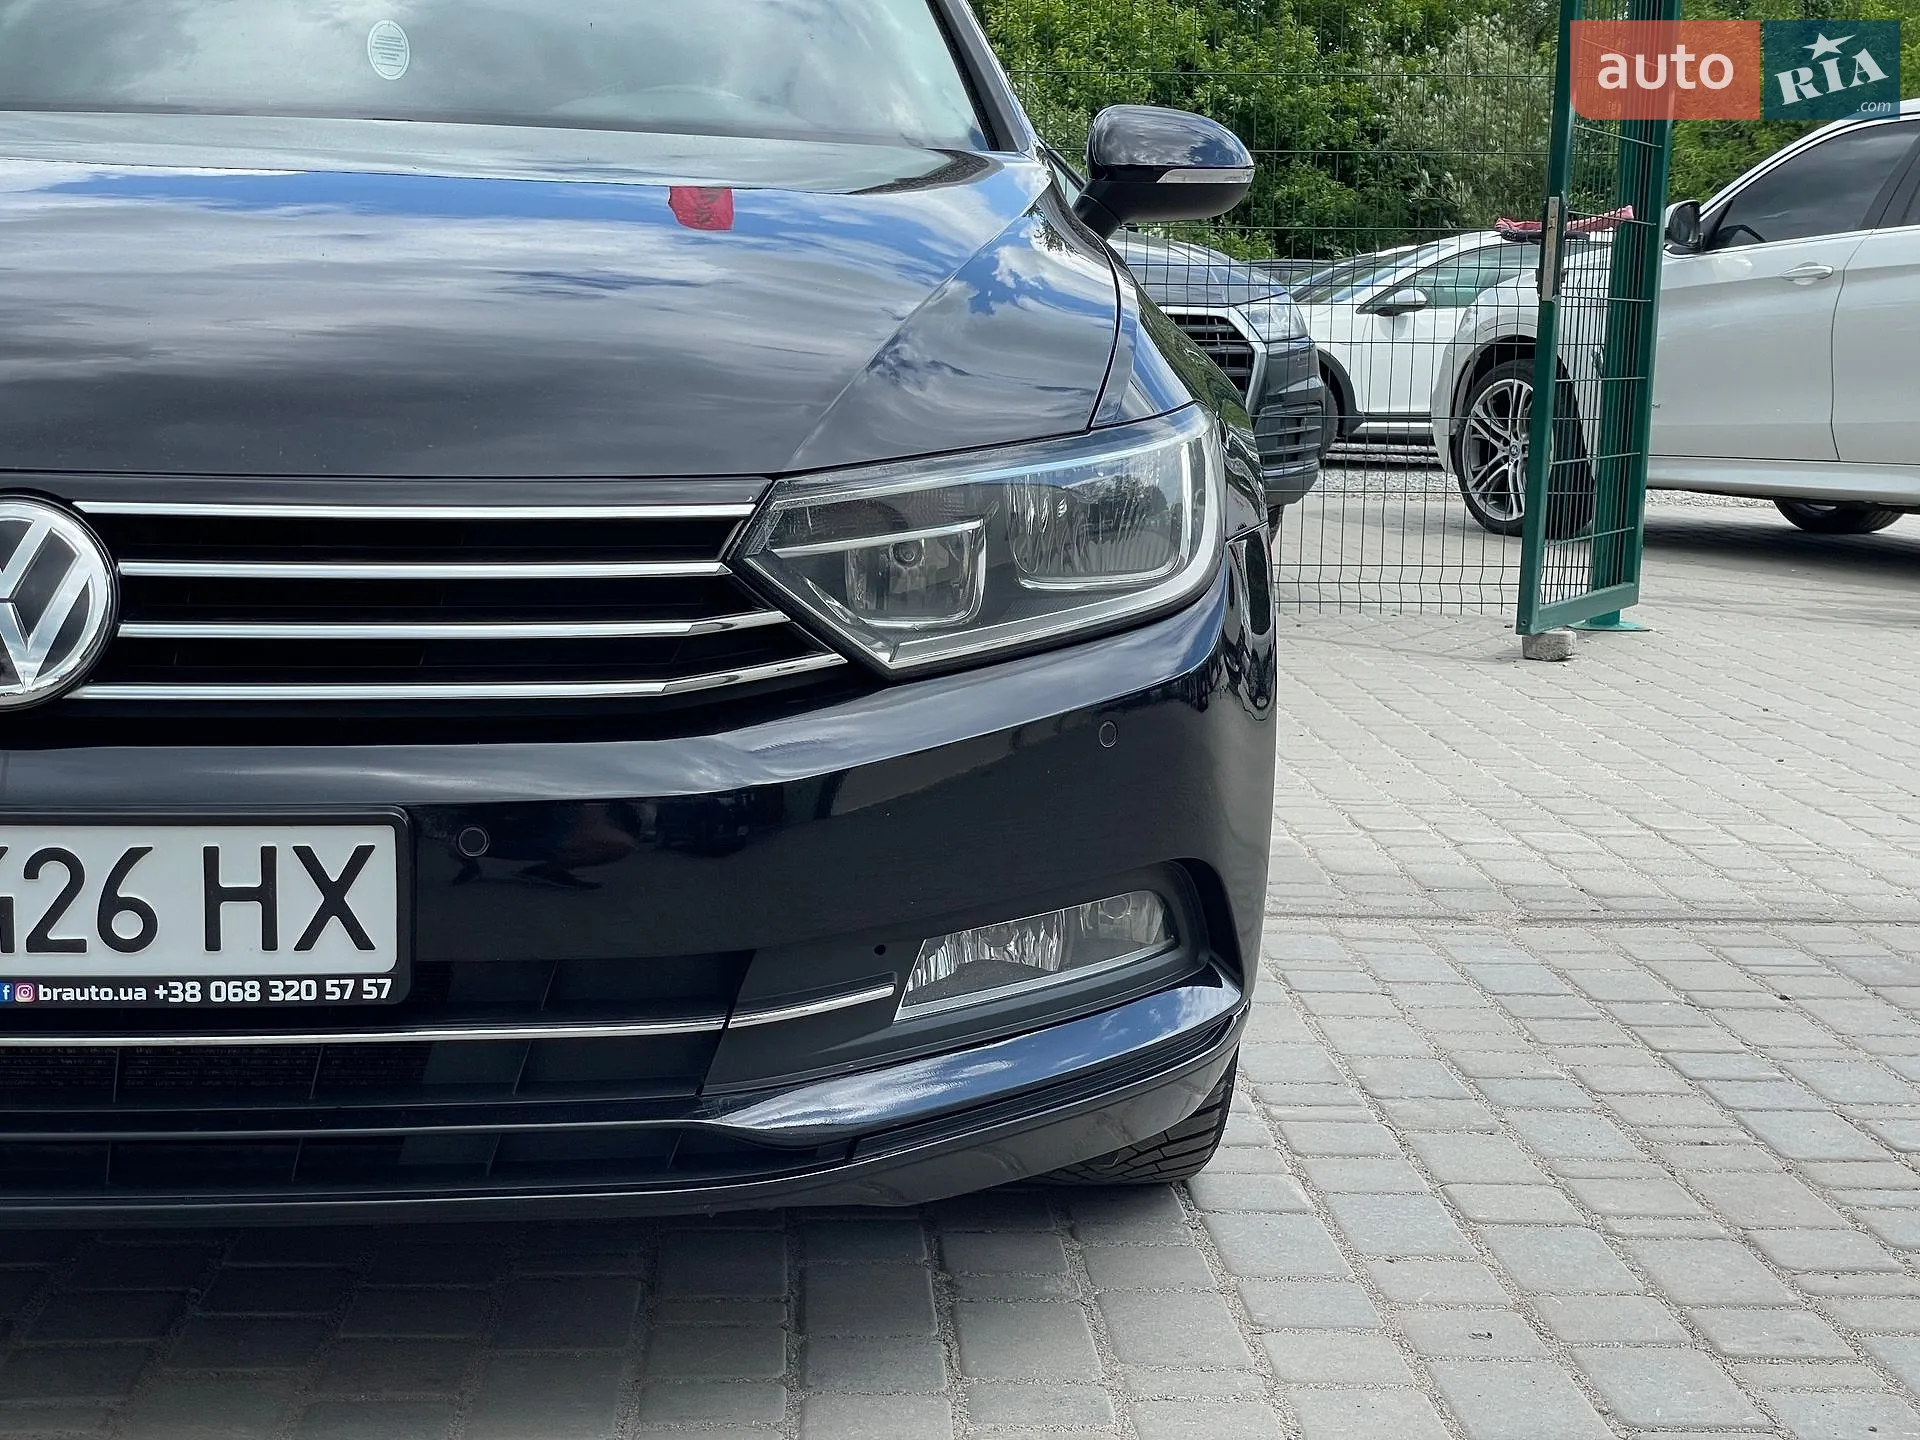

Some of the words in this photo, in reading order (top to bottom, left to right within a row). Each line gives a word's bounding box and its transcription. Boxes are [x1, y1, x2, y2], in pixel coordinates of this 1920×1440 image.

[203, 844, 377, 952] HX
[38, 984, 146, 1001] brauto.ua
[154, 981, 202, 1003] +38
[209, 980, 261, 1003] 068
[268, 979, 317, 1002] 320
[325, 979, 354, 1000] 57
[362, 978, 392, 999] 57
